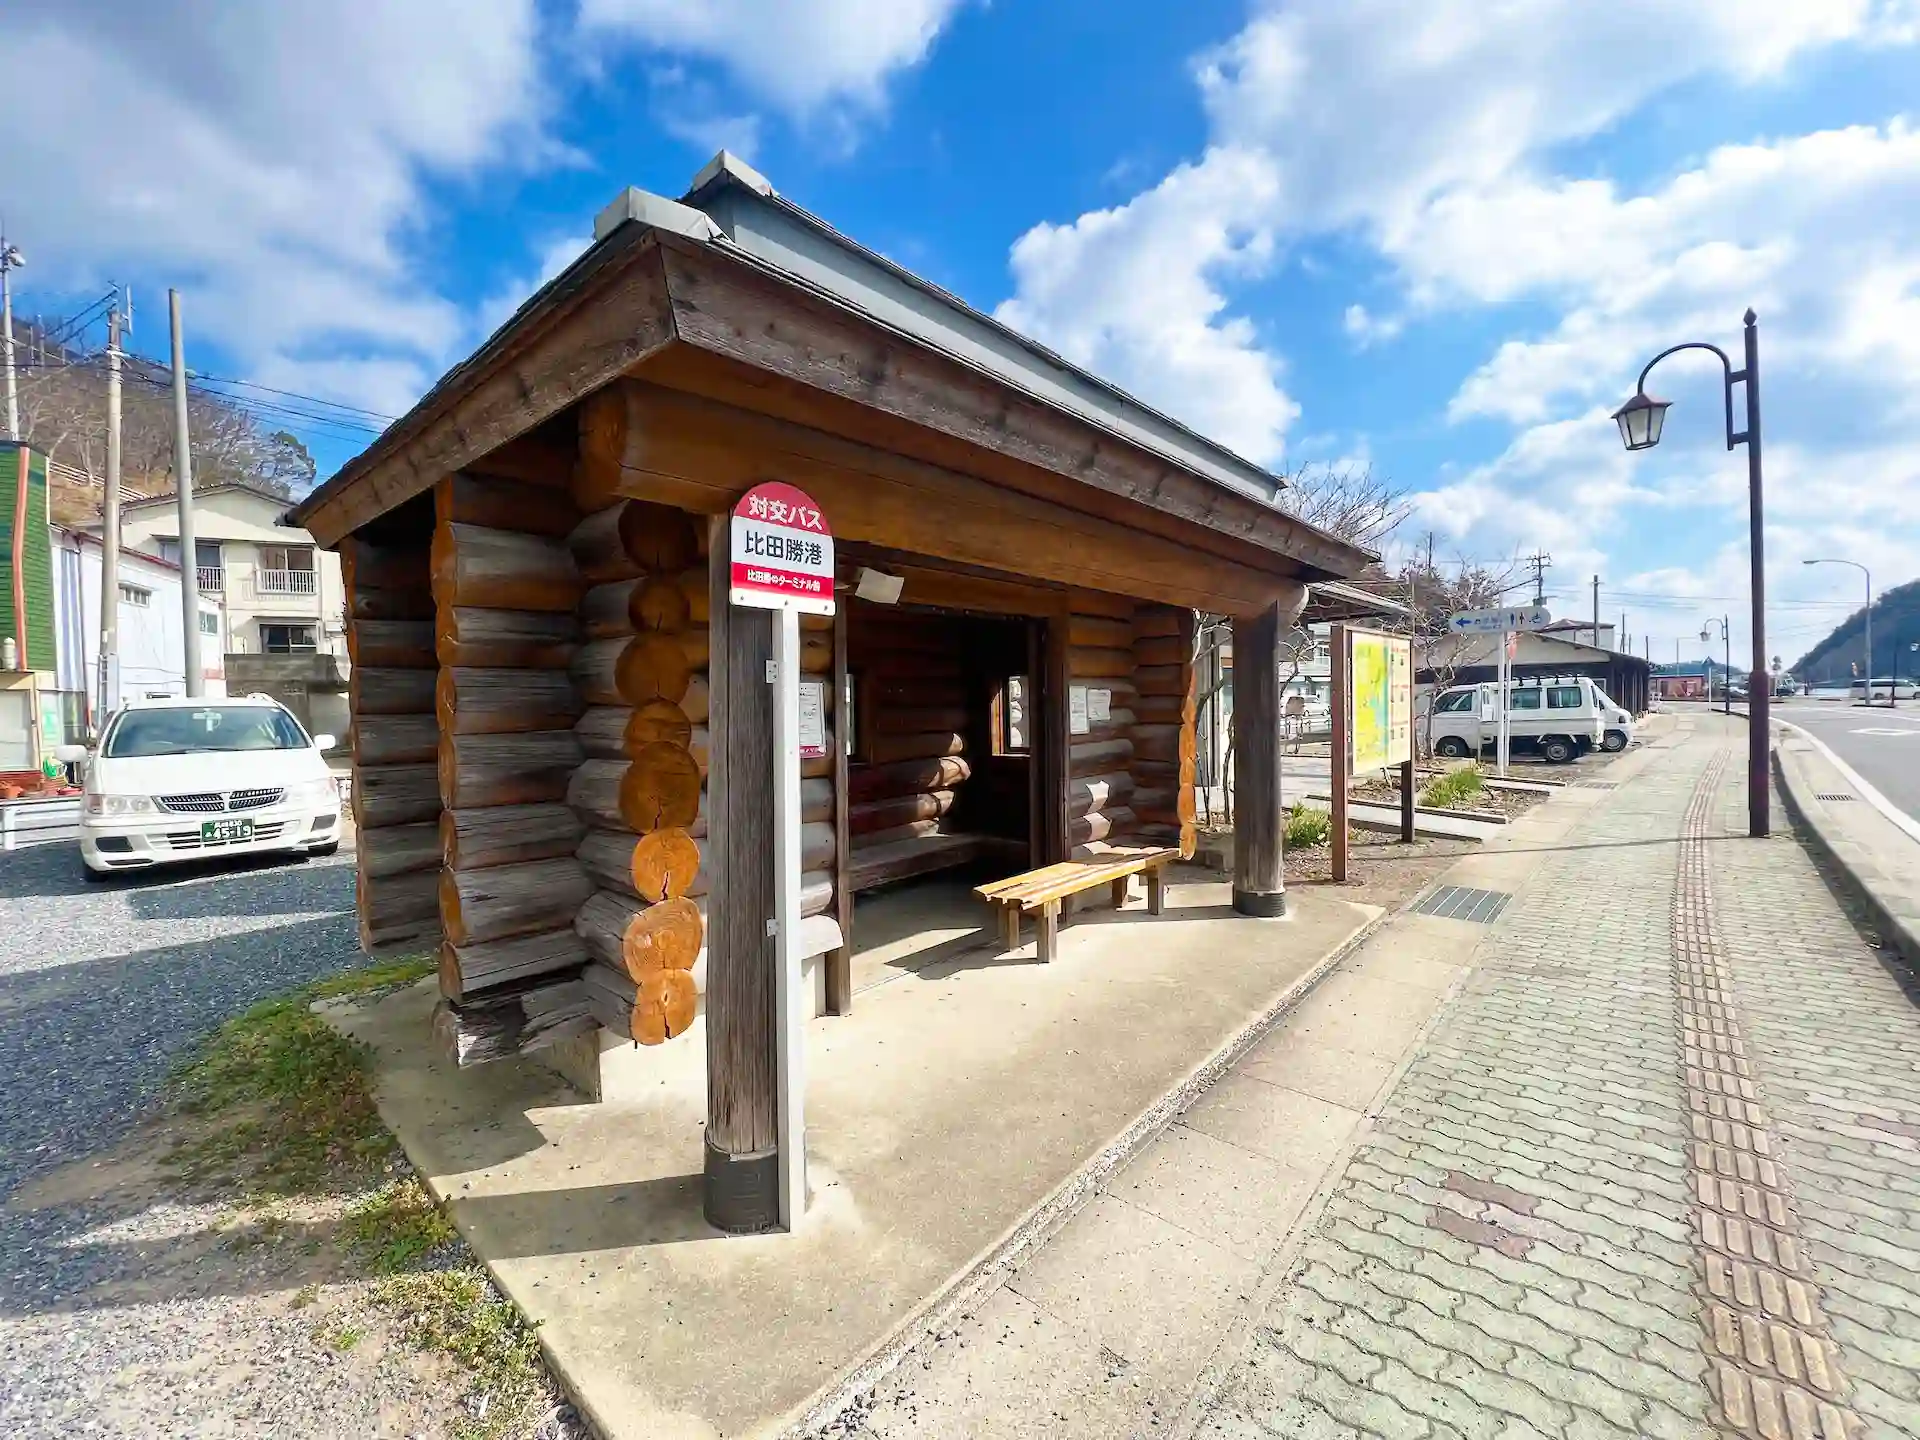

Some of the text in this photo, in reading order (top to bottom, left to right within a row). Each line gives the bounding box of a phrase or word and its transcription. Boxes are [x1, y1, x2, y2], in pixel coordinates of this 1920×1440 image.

[748, 494, 823, 530] 対交バス
[744, 529, 822, 566] 比田勝港
[213, 825, 252, 840] 45-19
